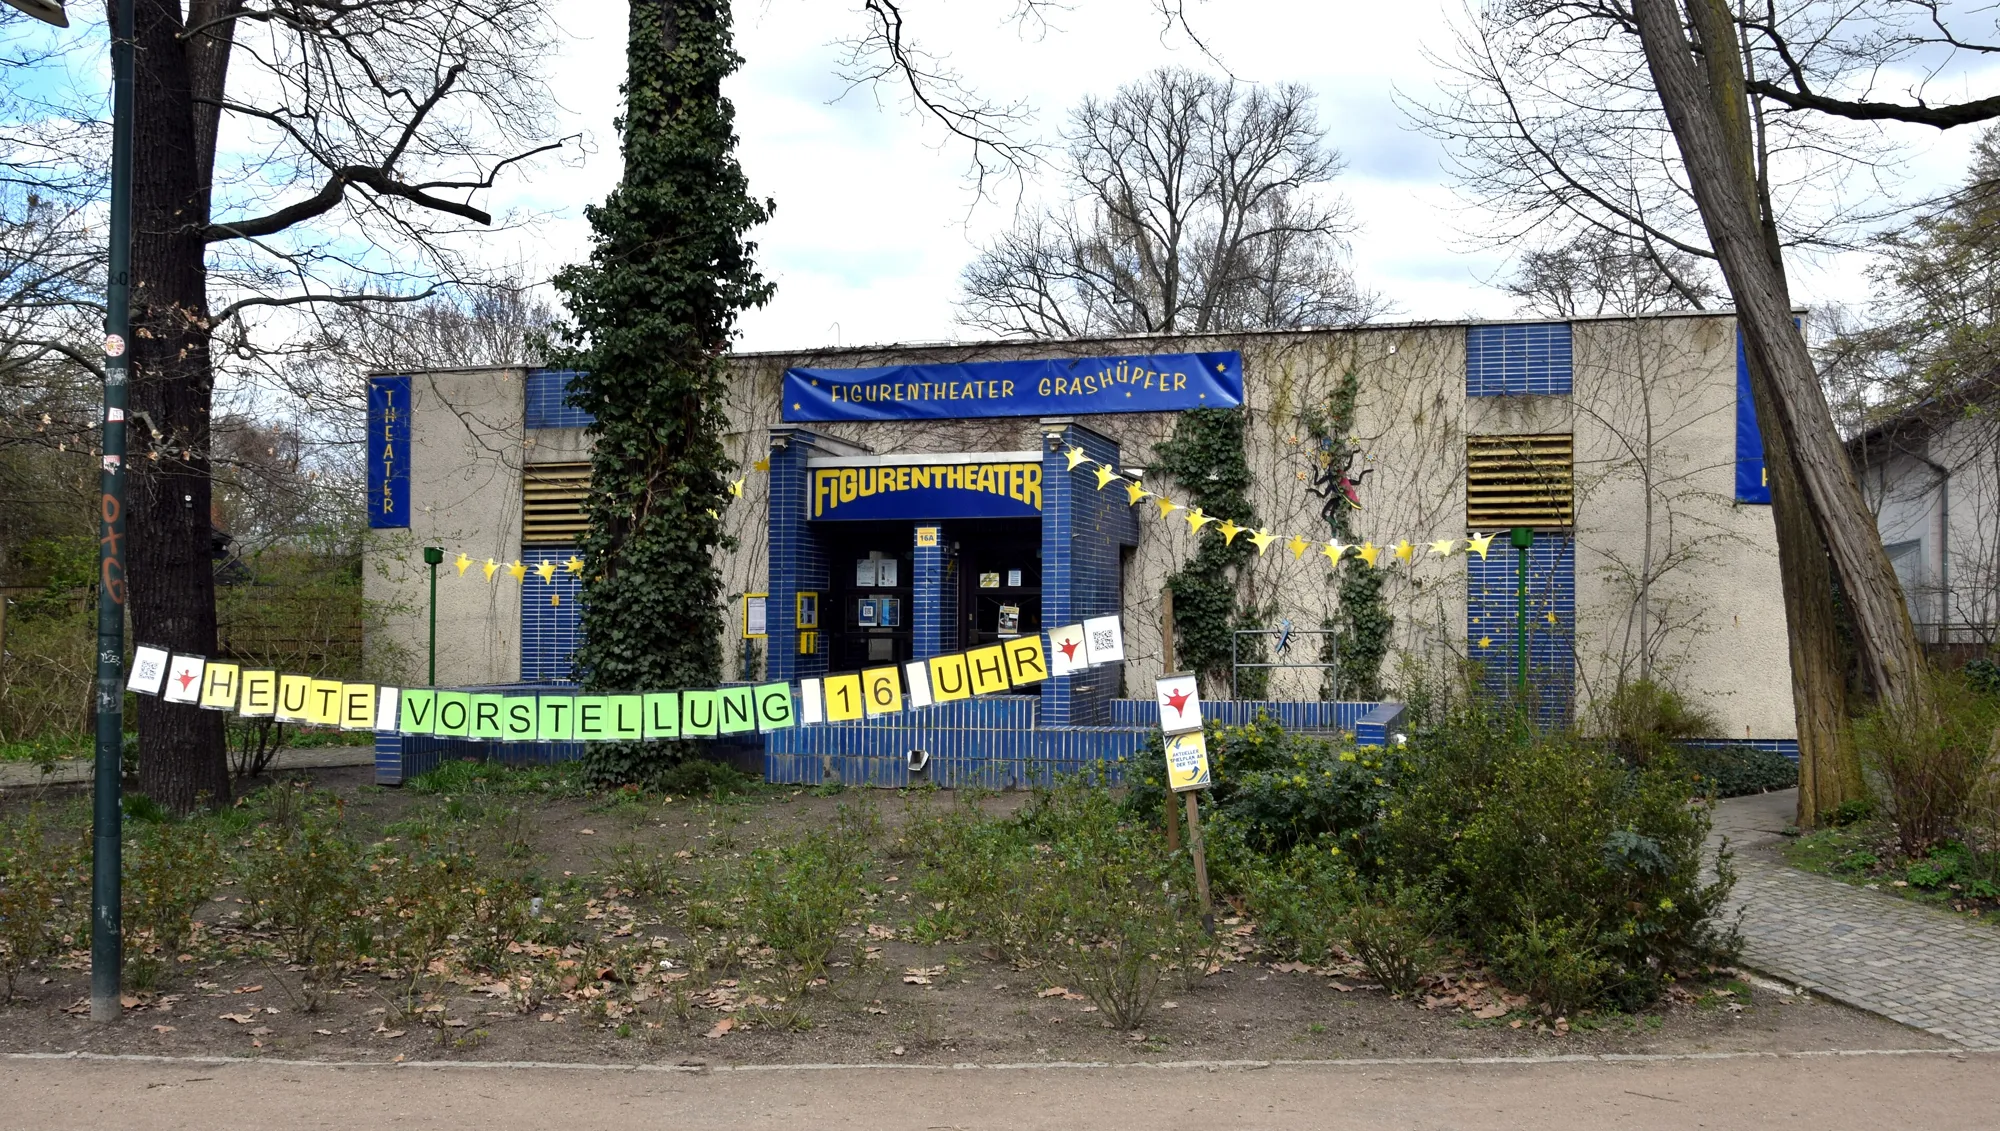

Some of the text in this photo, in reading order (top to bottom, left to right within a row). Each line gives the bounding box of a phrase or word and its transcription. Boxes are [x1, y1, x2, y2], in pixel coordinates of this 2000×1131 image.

[831, 360, 1187, 403] FIGURENTHEATER GRASHÜPFER
[383, 390, 395, 514] THEATER
[815, 463, 1042, 517] FIGURENTHEATER
[209, 646, 1042, 733] HEUTE VORSTELLUNG 16 UHR
[1170, 755, 1195, 763] SPIELPLAN
